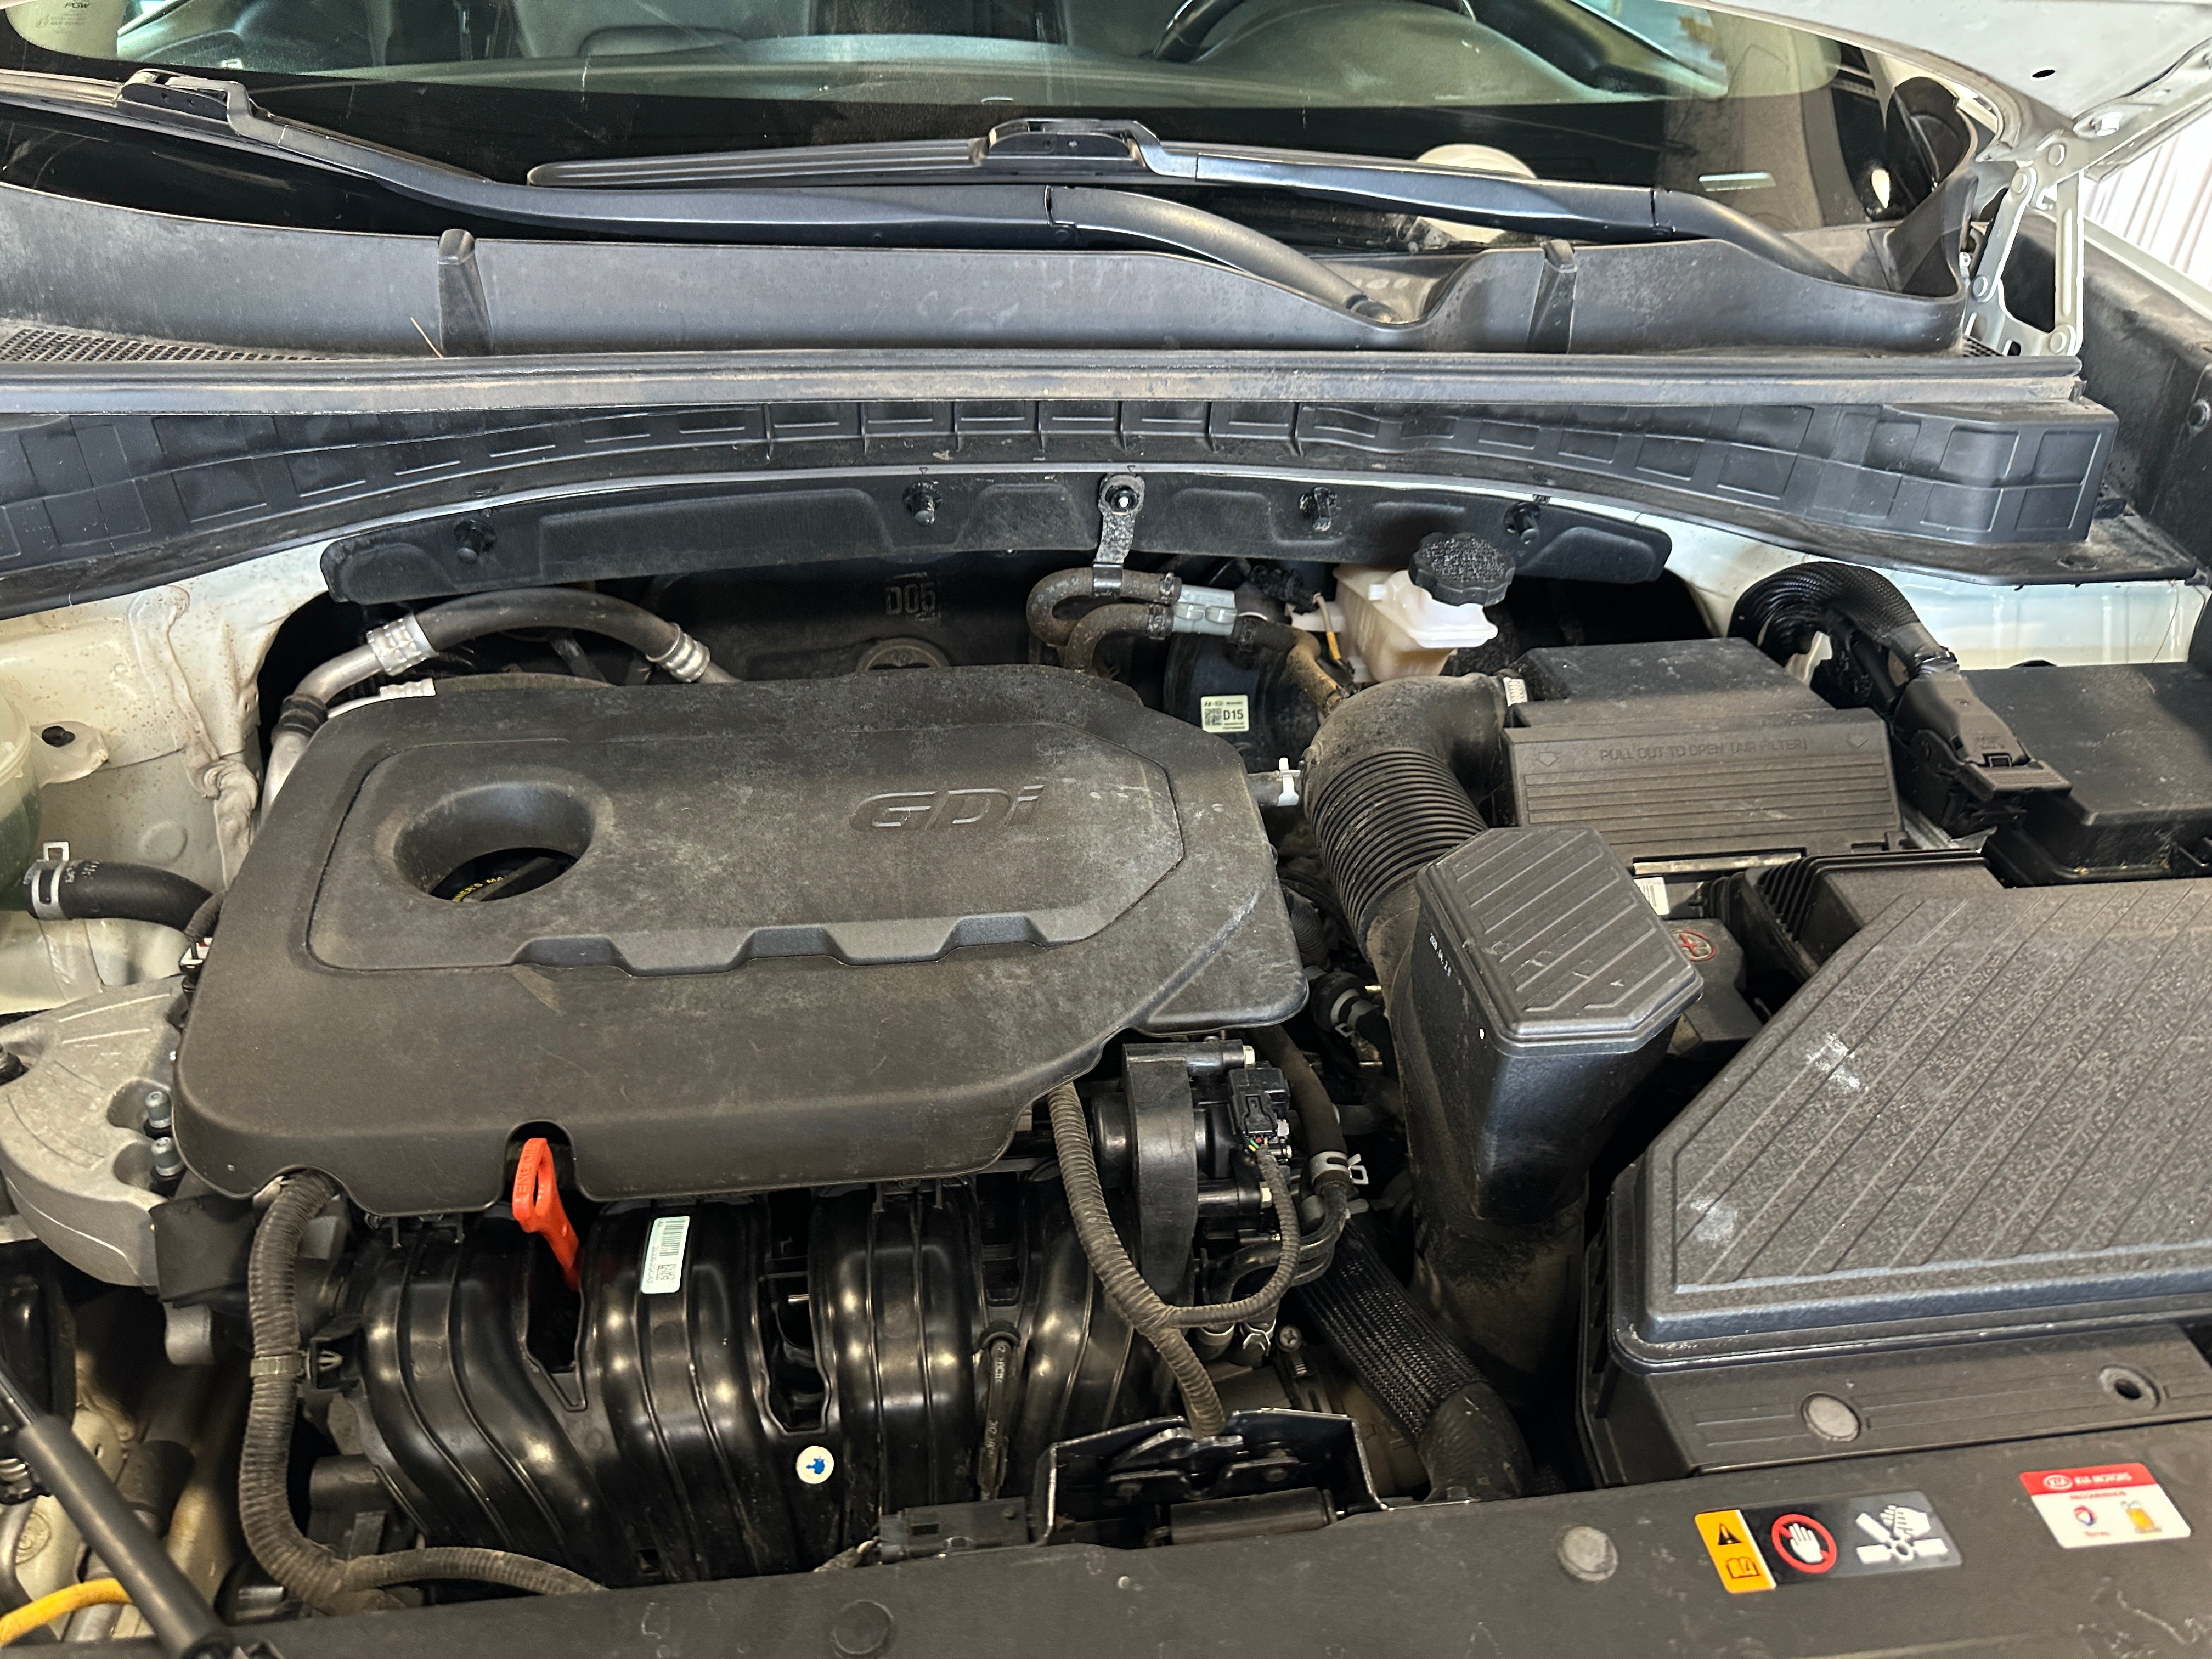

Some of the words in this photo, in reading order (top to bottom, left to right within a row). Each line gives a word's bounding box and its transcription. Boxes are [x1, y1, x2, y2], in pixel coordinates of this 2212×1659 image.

[1223, 709, 1244, 720] D15
[1599, 749, 1635, 761] PULL
[1638, 746, 1664, 759] OUT
[1668, 745, 1685, 757] TO
[1689, 742, 1724, 757] OPEN
[849, 785, 1045, 830] GDi
[523, 1144, 536, 1162] OIL
[516, 1166, 532, 1194] ENG
[2045, 1476, 2070, 1488] KIA
